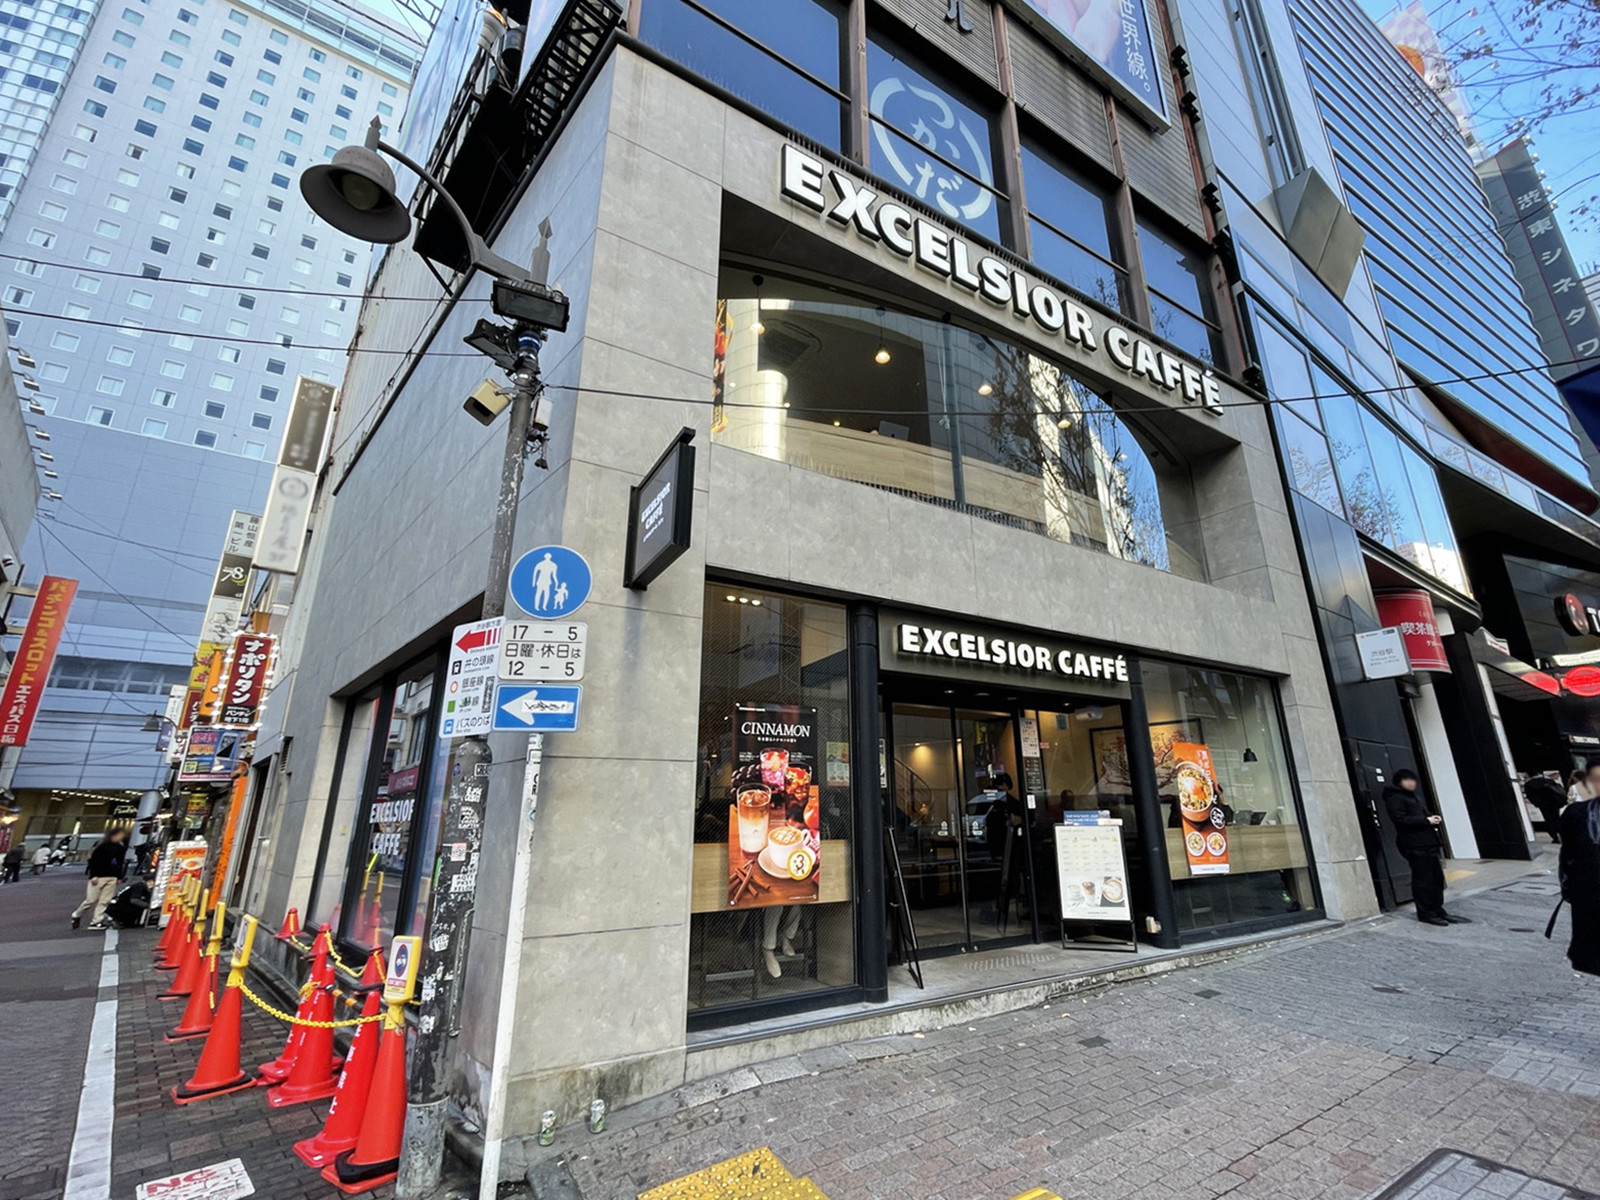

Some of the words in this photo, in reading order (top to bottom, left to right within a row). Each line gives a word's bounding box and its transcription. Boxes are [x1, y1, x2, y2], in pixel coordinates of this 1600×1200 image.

[781, 143, 1097, 352] EXCELSIOR
[1104, 325, 1225, 416] CAFFÉ
[512, 625, 529, 640] 17
[567, 626, 578, 641] 5
[901, 623, 1053, 671] EXCELSIOR
[1057, 649, 1129, 682] CAFFÉ
[231, 639, 267, 704] ナポリタン
[508, 660, 525, 676] 12
[564, 662, 575, 677] 5
[456, 714, 491, 729] バスのりば
[741, 721, 811, 738] CINNAMON
